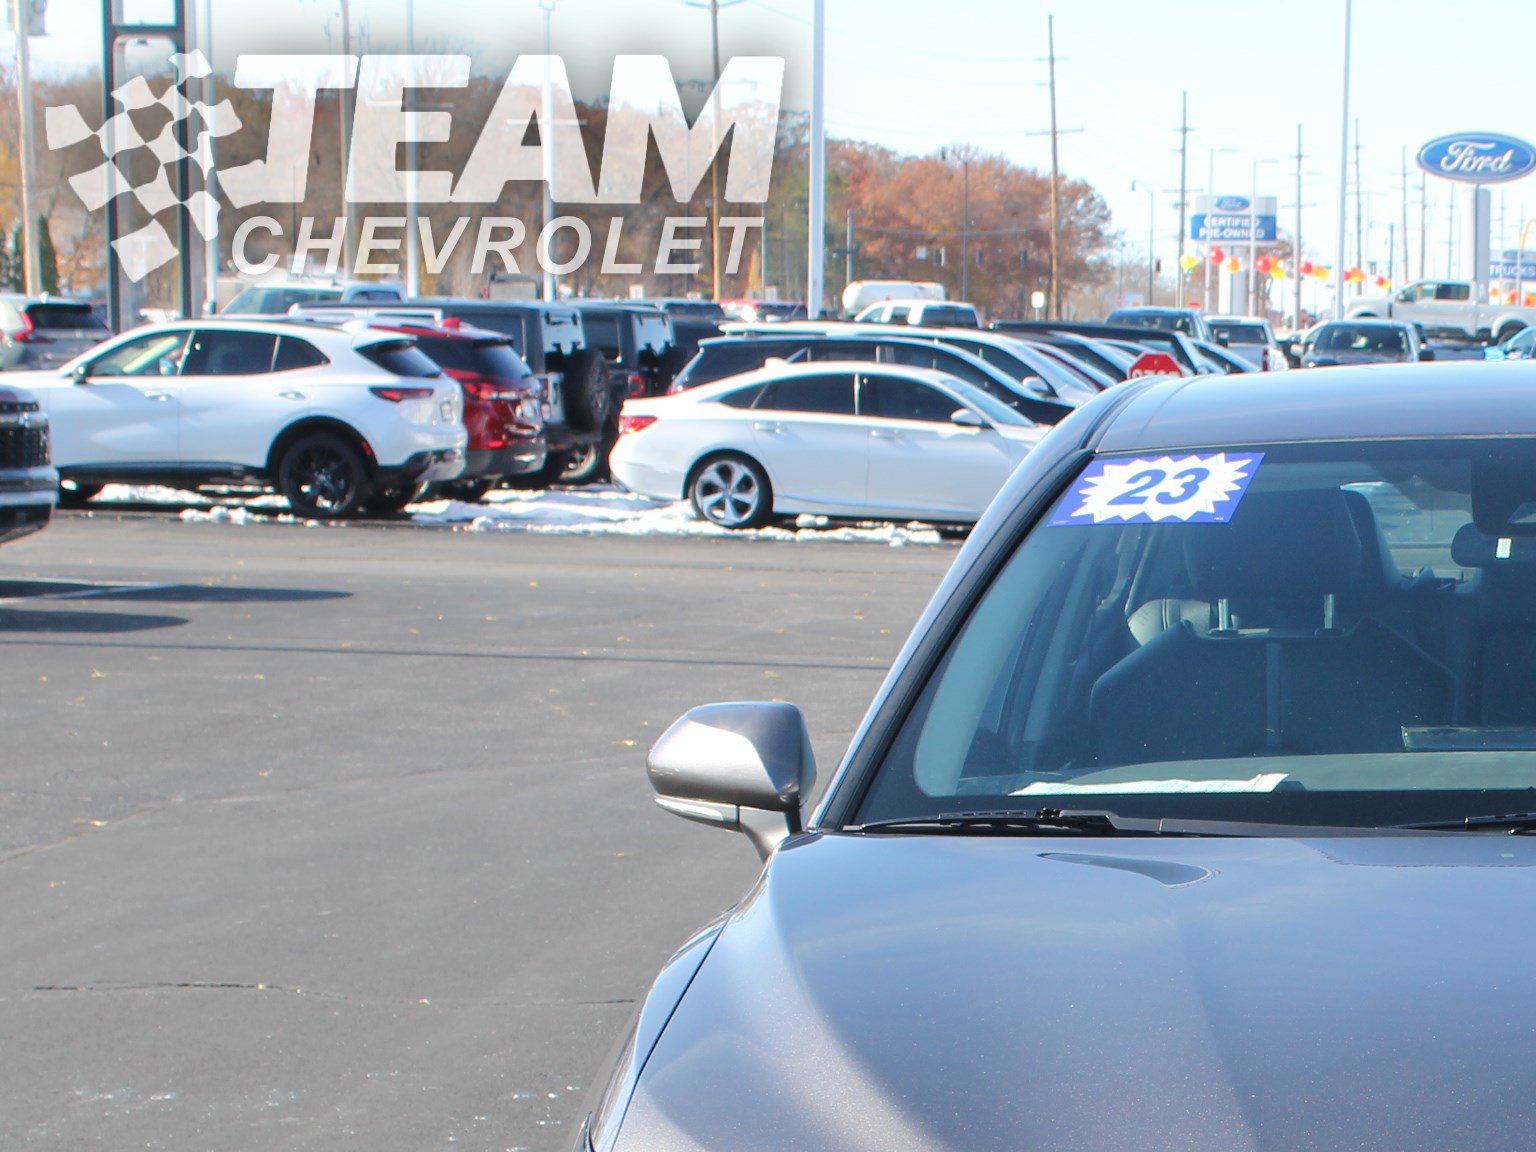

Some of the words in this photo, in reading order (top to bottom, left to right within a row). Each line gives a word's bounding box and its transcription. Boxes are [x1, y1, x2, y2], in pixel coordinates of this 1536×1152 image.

[1441, 140, 1514, 172] Ford
[1199, 228, 1264, 238] PE-OWND
[1106, 467, 1210, 506] 23
